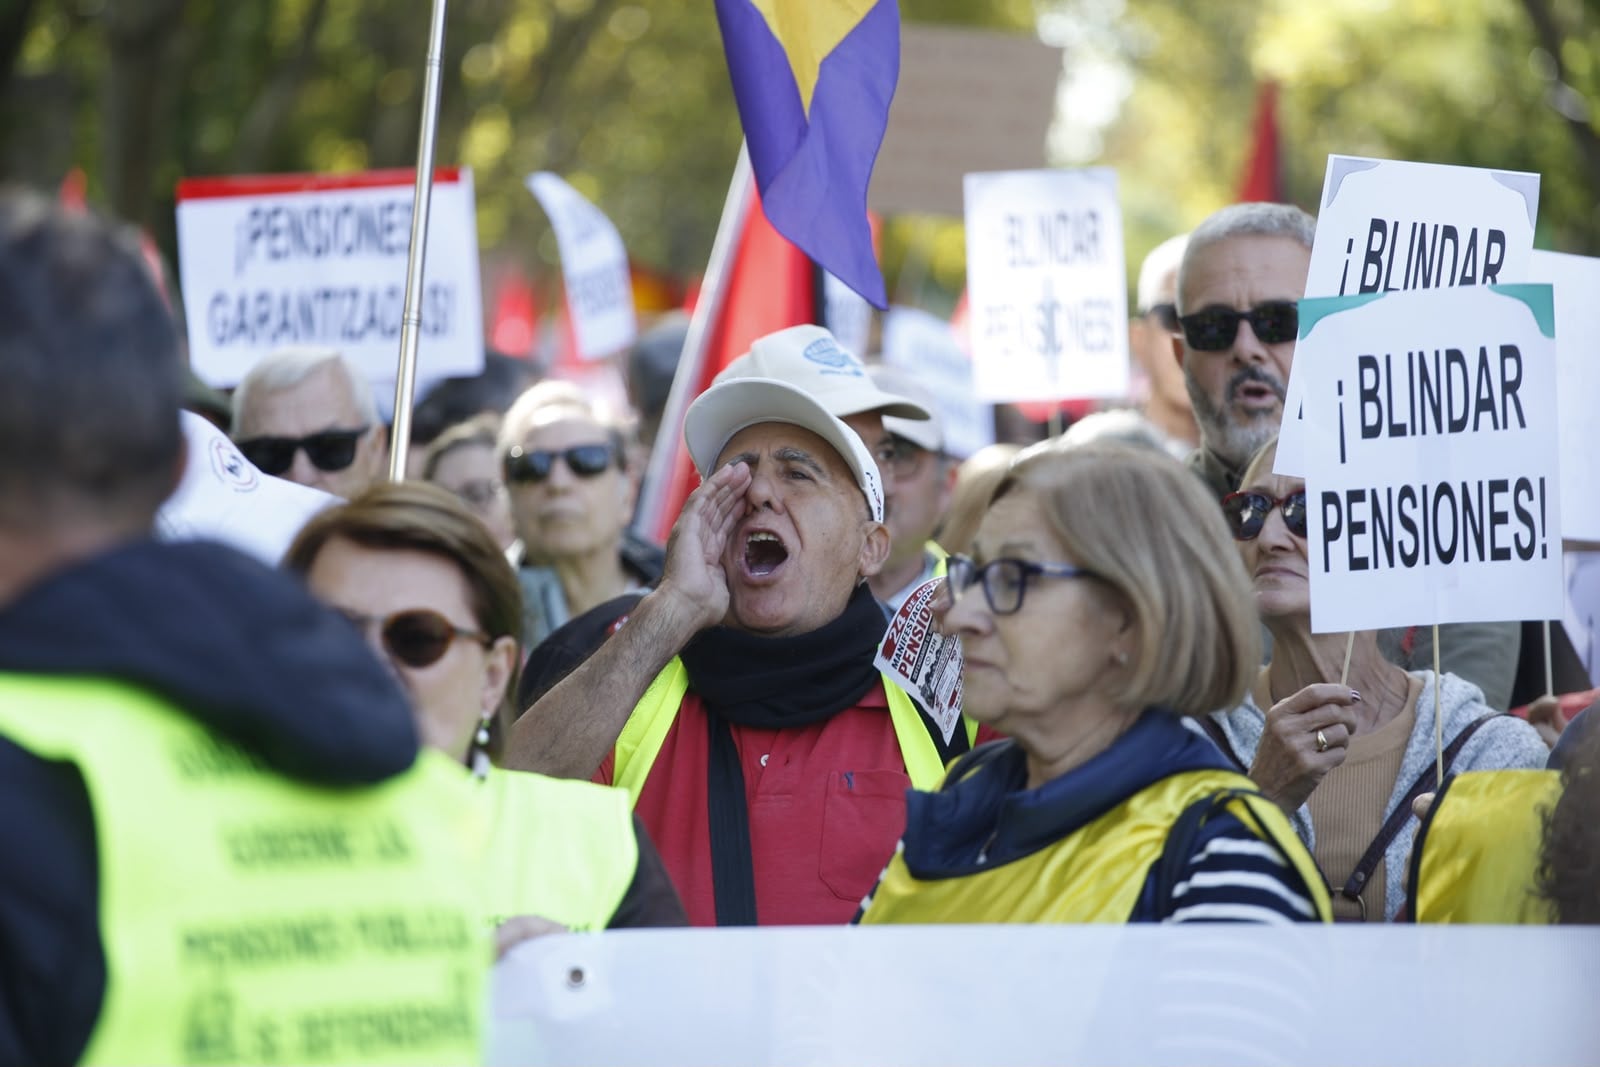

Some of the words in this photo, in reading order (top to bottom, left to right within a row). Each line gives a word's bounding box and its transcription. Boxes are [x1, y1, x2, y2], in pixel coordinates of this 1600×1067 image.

[208, 284, 453, 347] GARANTIZADS!
[1358, 344, 1526, 440] BLINDAR
[1321, 476, 1549, 573] PENSIONES!
[889, 614, 906, 646] 24
